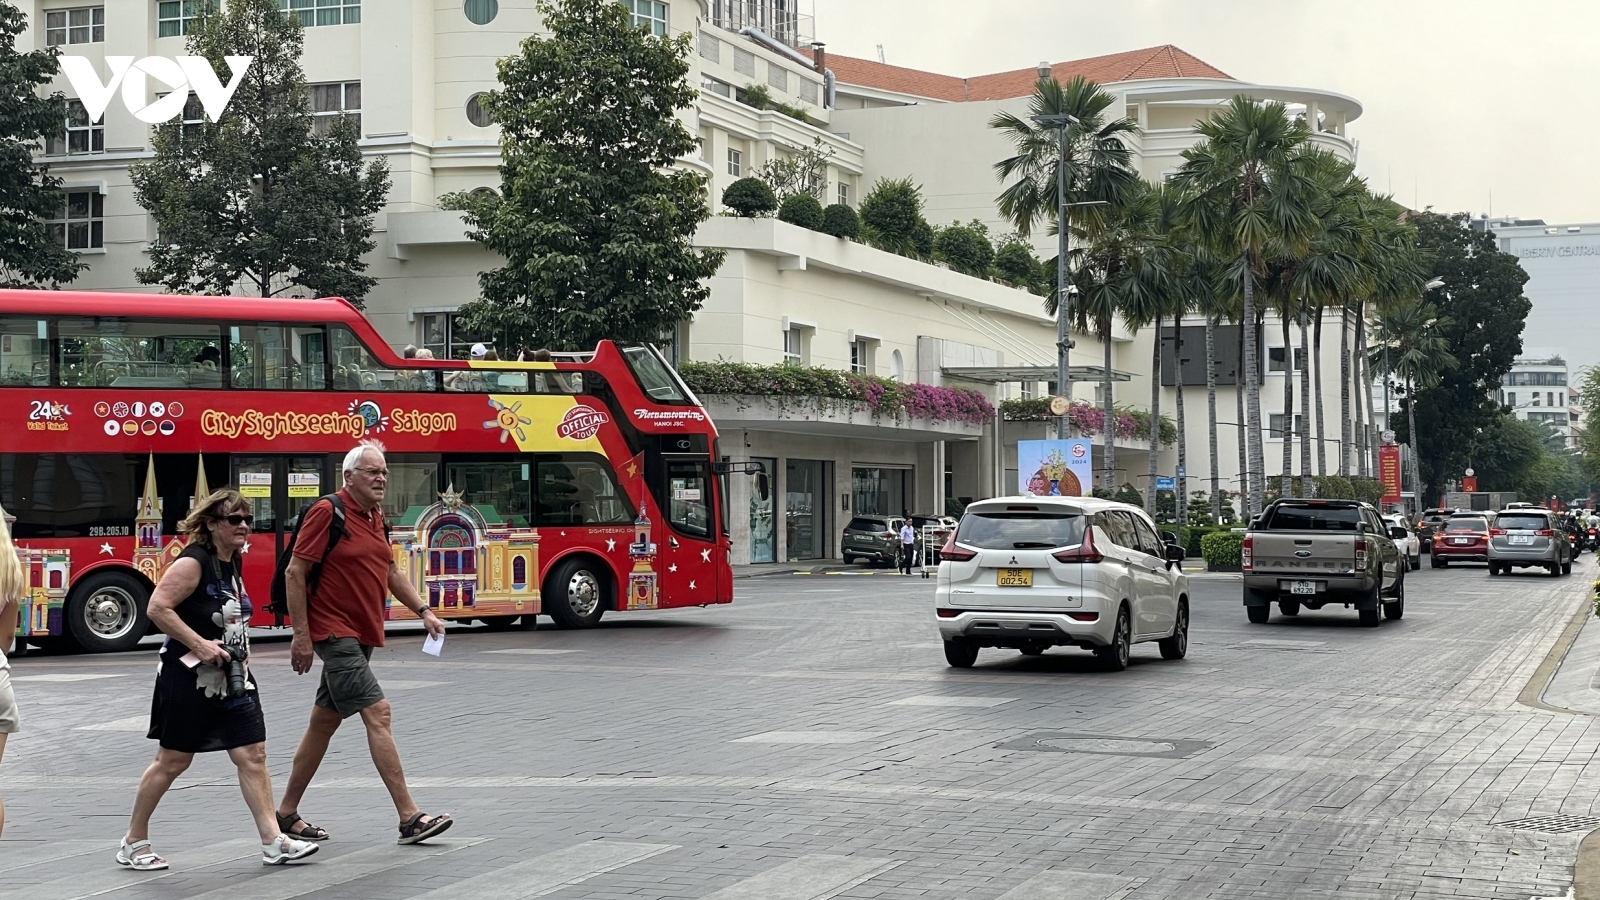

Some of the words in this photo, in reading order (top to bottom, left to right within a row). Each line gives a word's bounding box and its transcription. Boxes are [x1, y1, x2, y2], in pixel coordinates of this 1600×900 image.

[1515, 246, 1556, 259] LIBERTY
[1557, 244, 1600, 257] CENTRAL
[29, 400, 51, 420] 24
[391, 408, 457, 436] Saigon
[561, 413, 606, 435] OFFICIAL
[576, 426, 597, 439] TOUR
[89, 526, 129, 536] 29B.205.10
[1255, 560, 1353, 569] RANGER
[1000, 577, 1028, 585] 002.54
